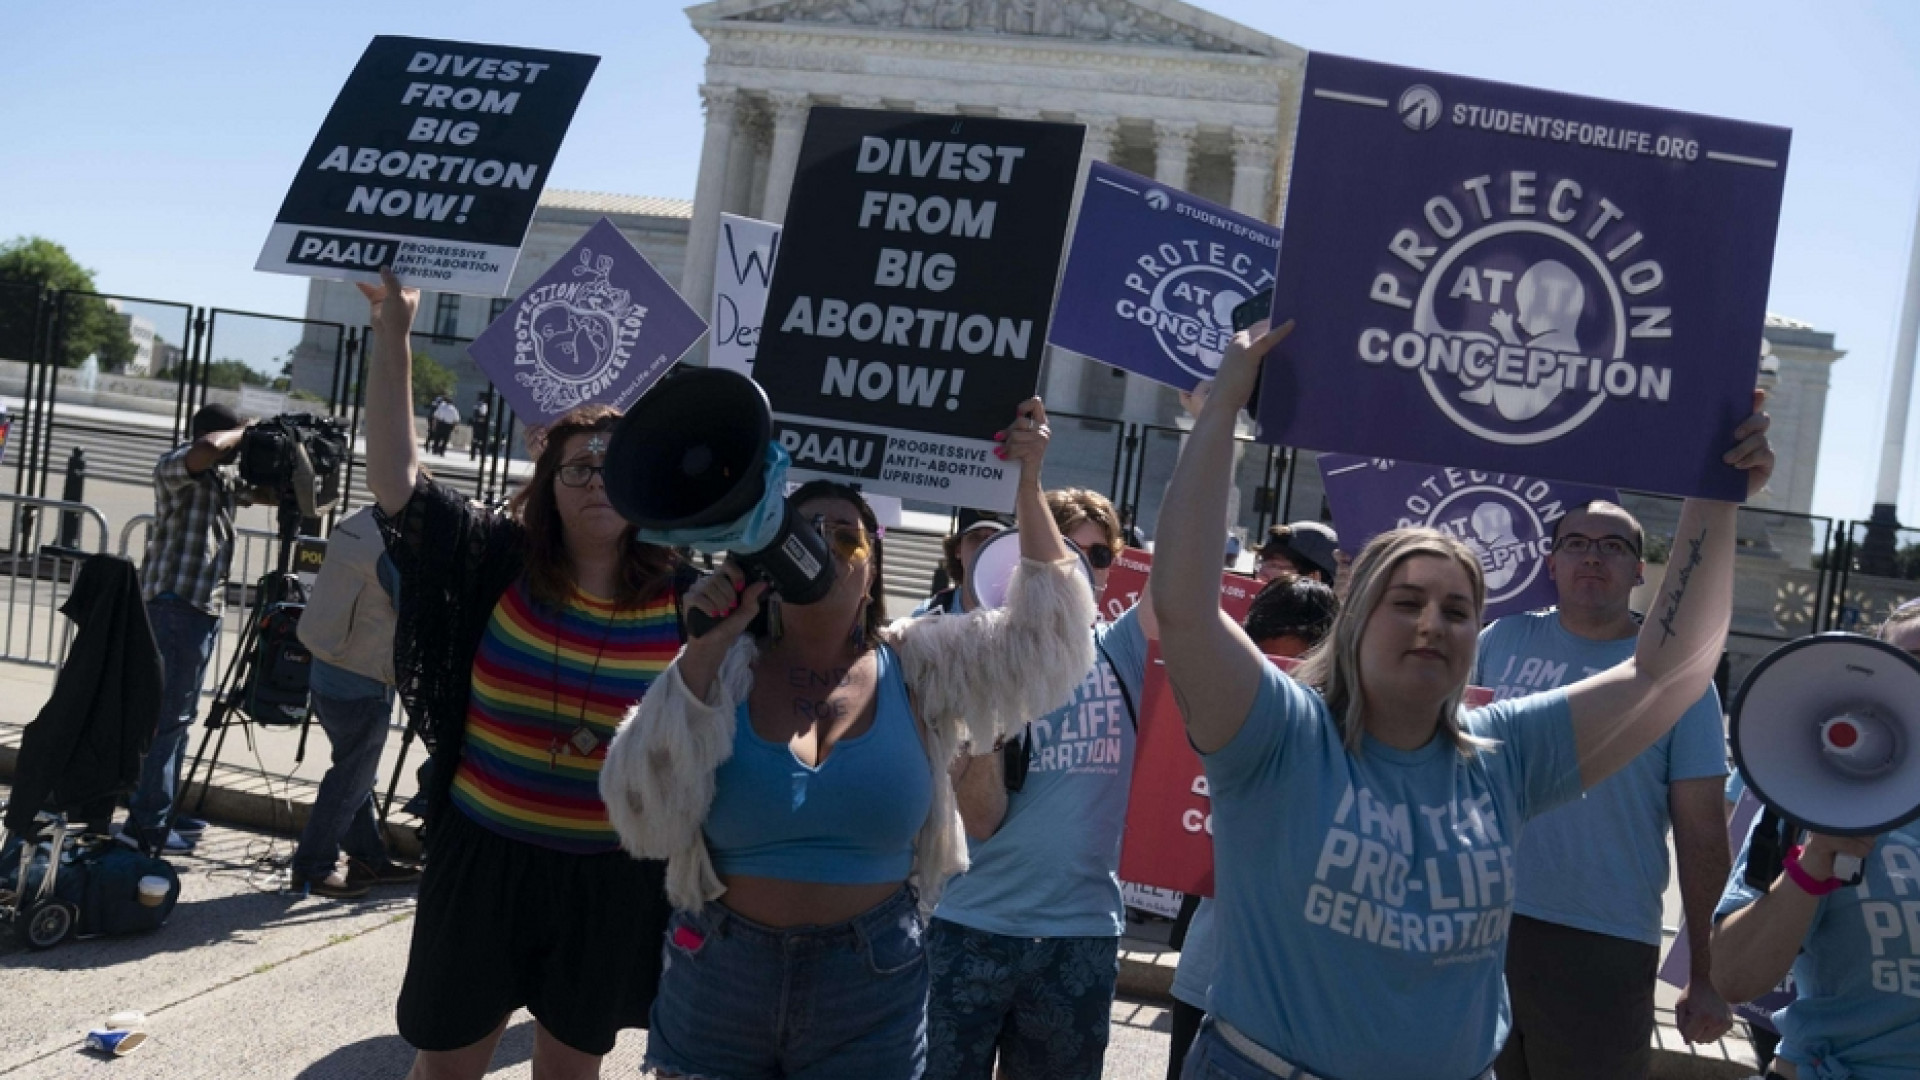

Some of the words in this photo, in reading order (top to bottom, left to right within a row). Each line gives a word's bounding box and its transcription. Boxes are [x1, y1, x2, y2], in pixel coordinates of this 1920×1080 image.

[406, 52, 549, 84] DIVEST
[401, 82, 521, 114] FROM
[407, 116, 480, 145] BIG
[1452, 103, 1699, 162] STUDENTSFORLIFE.ORG
[317, 145, 537, 190] ABORTION
[855, 135, 1025, 184] DIVEST
[346, 186, 476, 224] NOW!
[858, 190, 997, 240] FROM
[298, 236, 388, 266] PAAU
[396, 254, 499, 273] ANTI-ABORTION
[401, 242, 487, 260] PROGRESSIVE
[874, 248, 957, 292] BIG
[1125, 239, 1276, 295] PROTECT
[1369, 170, 1672, 339] PROTECTION
[392, 266, 451, 280] UPRISING
[1173, 281, 1211, 305] AT
[1450, 266, 1514, 305] AT
[514, 282, 582, 366] PROTECTION
[780, 296, 1032, 359] ABORTION
[1116, 299, 1233, 351] CONCEP
[581, 303, 649, 401] CONCEPTION
[1357, 327, 1672, 402] CONCEPTION
[820, 356, 965, 412] NOW!
[779, 429, 874, 469] PAAU
[886, 454, 1004, 481] ANTI-ABORTION
[888, 437, 987, 462] PROGRESSIVE
[882, 471, 950, 489] UPRISING
[1333, 782, 1355, 824] I
[1358, 787, 1414, 856] AM
